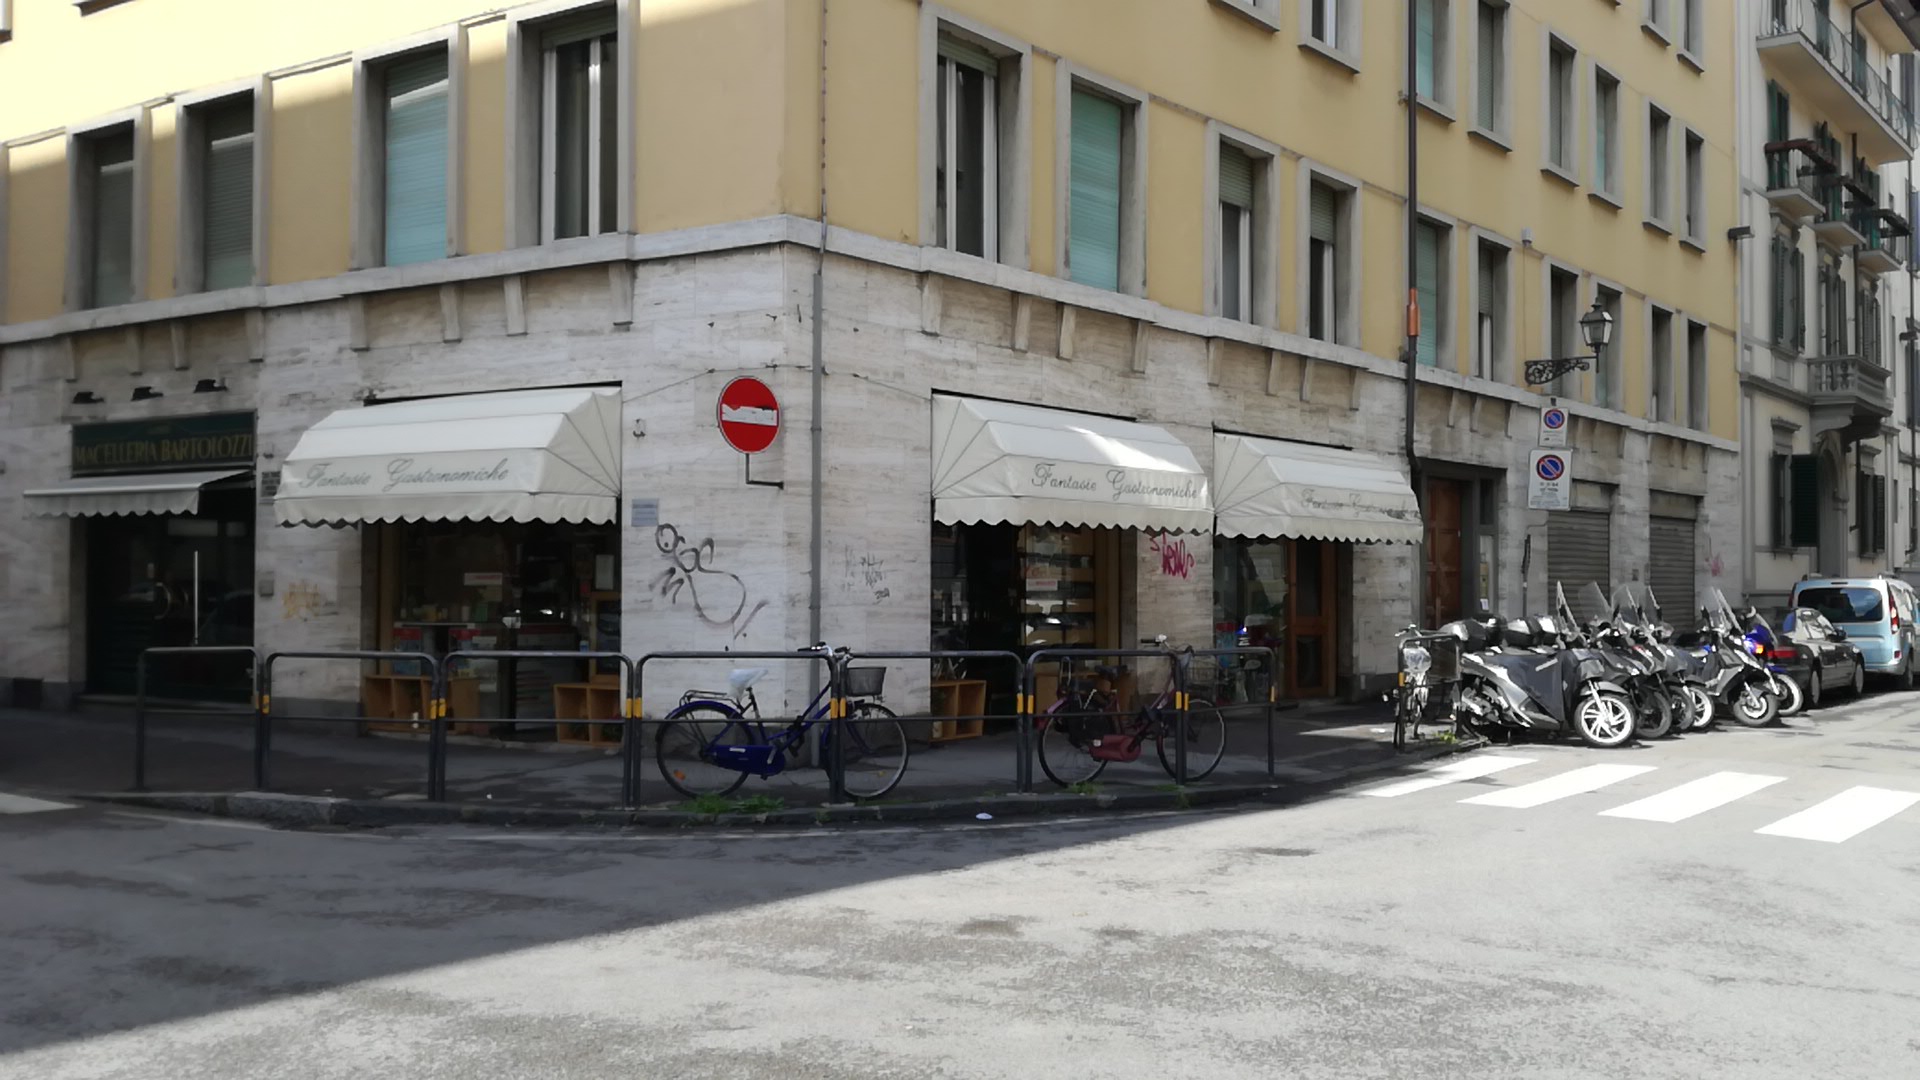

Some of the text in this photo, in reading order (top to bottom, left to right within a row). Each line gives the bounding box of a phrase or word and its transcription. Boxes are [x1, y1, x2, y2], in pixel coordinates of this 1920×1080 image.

[75, 440, 158, 466] MACELLERIA
[300, 462, 372, 488] Fantasie
[381, 457, 509, 492] Gastronomiche
[1032, 463, 1197, 500] Fantasie Gastronomiche
